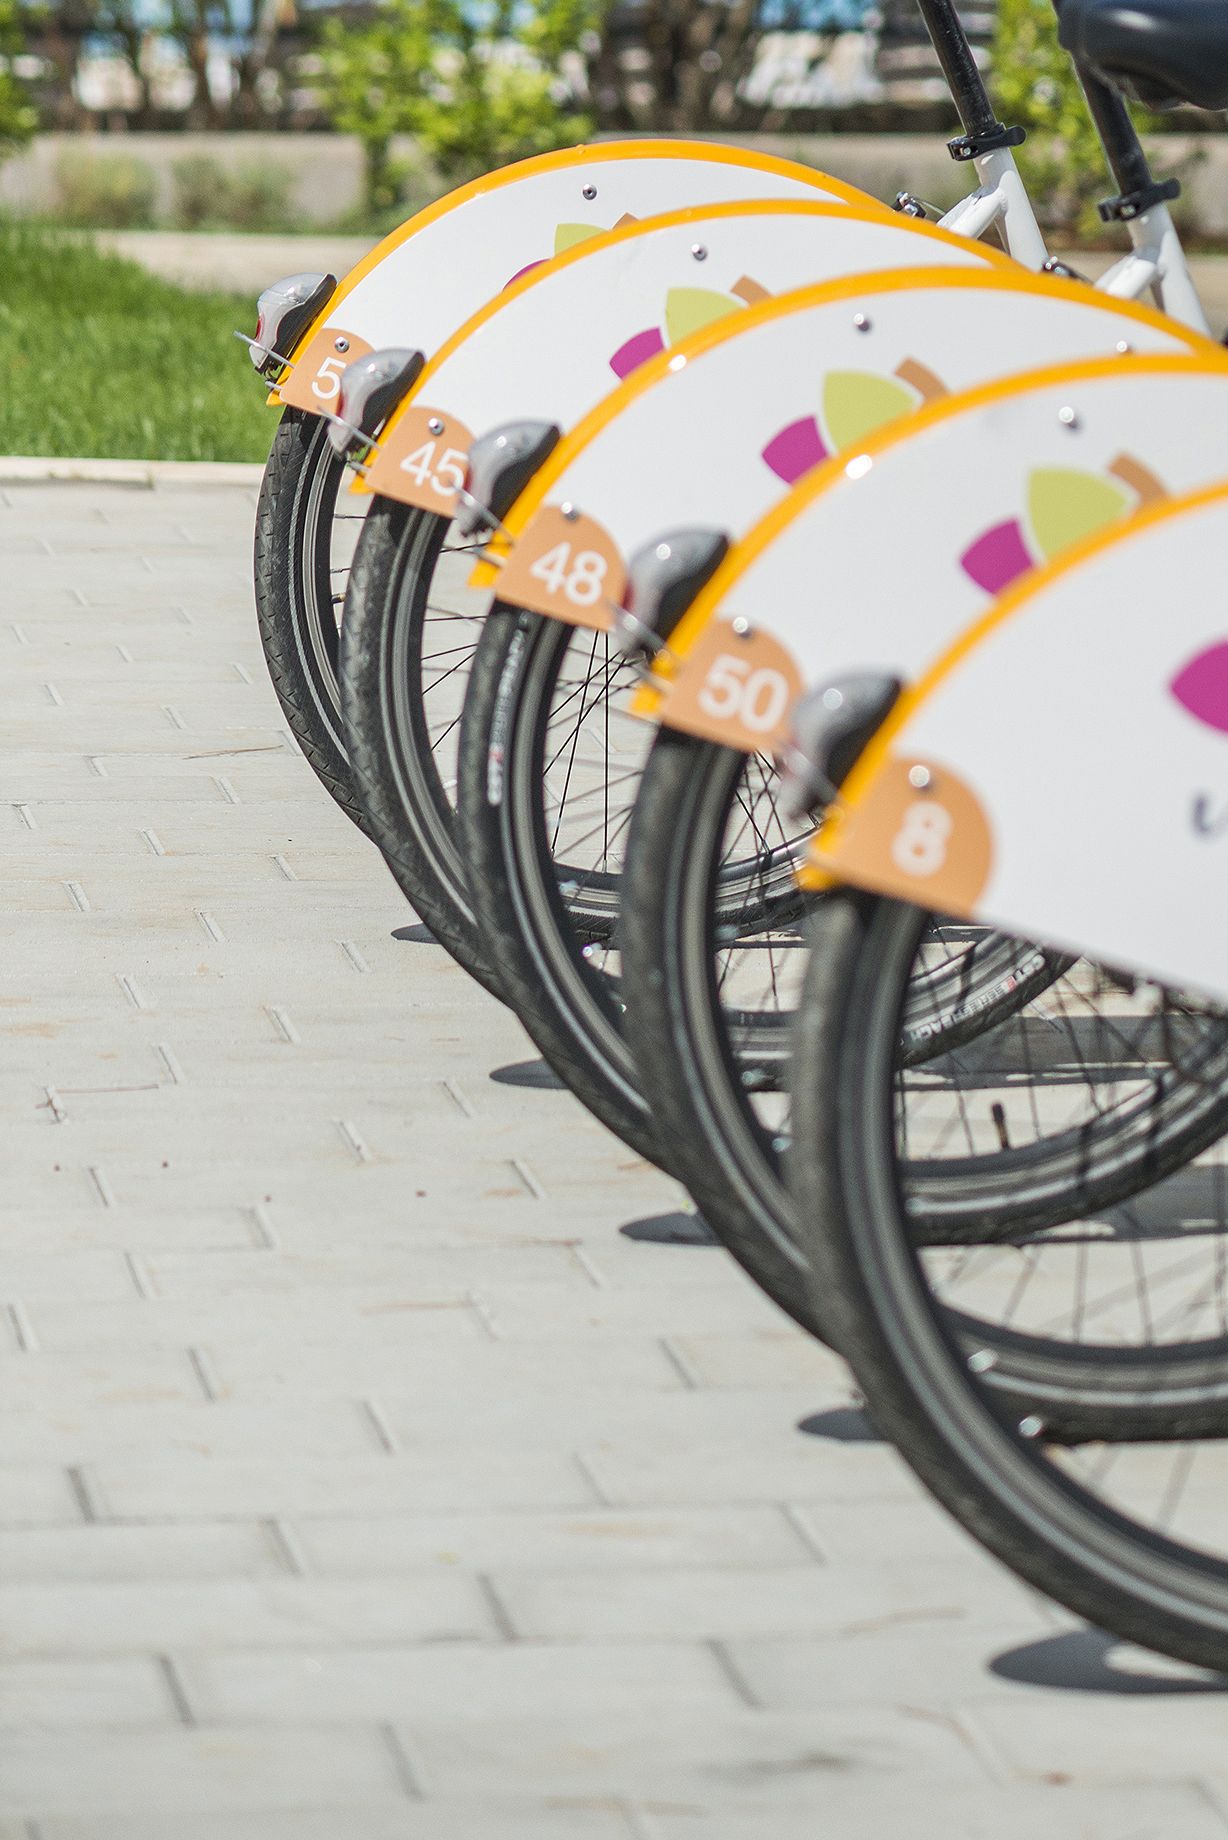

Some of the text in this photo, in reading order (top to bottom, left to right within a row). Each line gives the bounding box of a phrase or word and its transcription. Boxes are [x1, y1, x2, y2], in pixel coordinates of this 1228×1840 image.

[311, 356, 346, 400] 5
[400, 441, 468, 497] 45
[529, 541, 608, 606] 48
[699, 654, 789, 733] 50
[890, 800, 953, 879] 8
